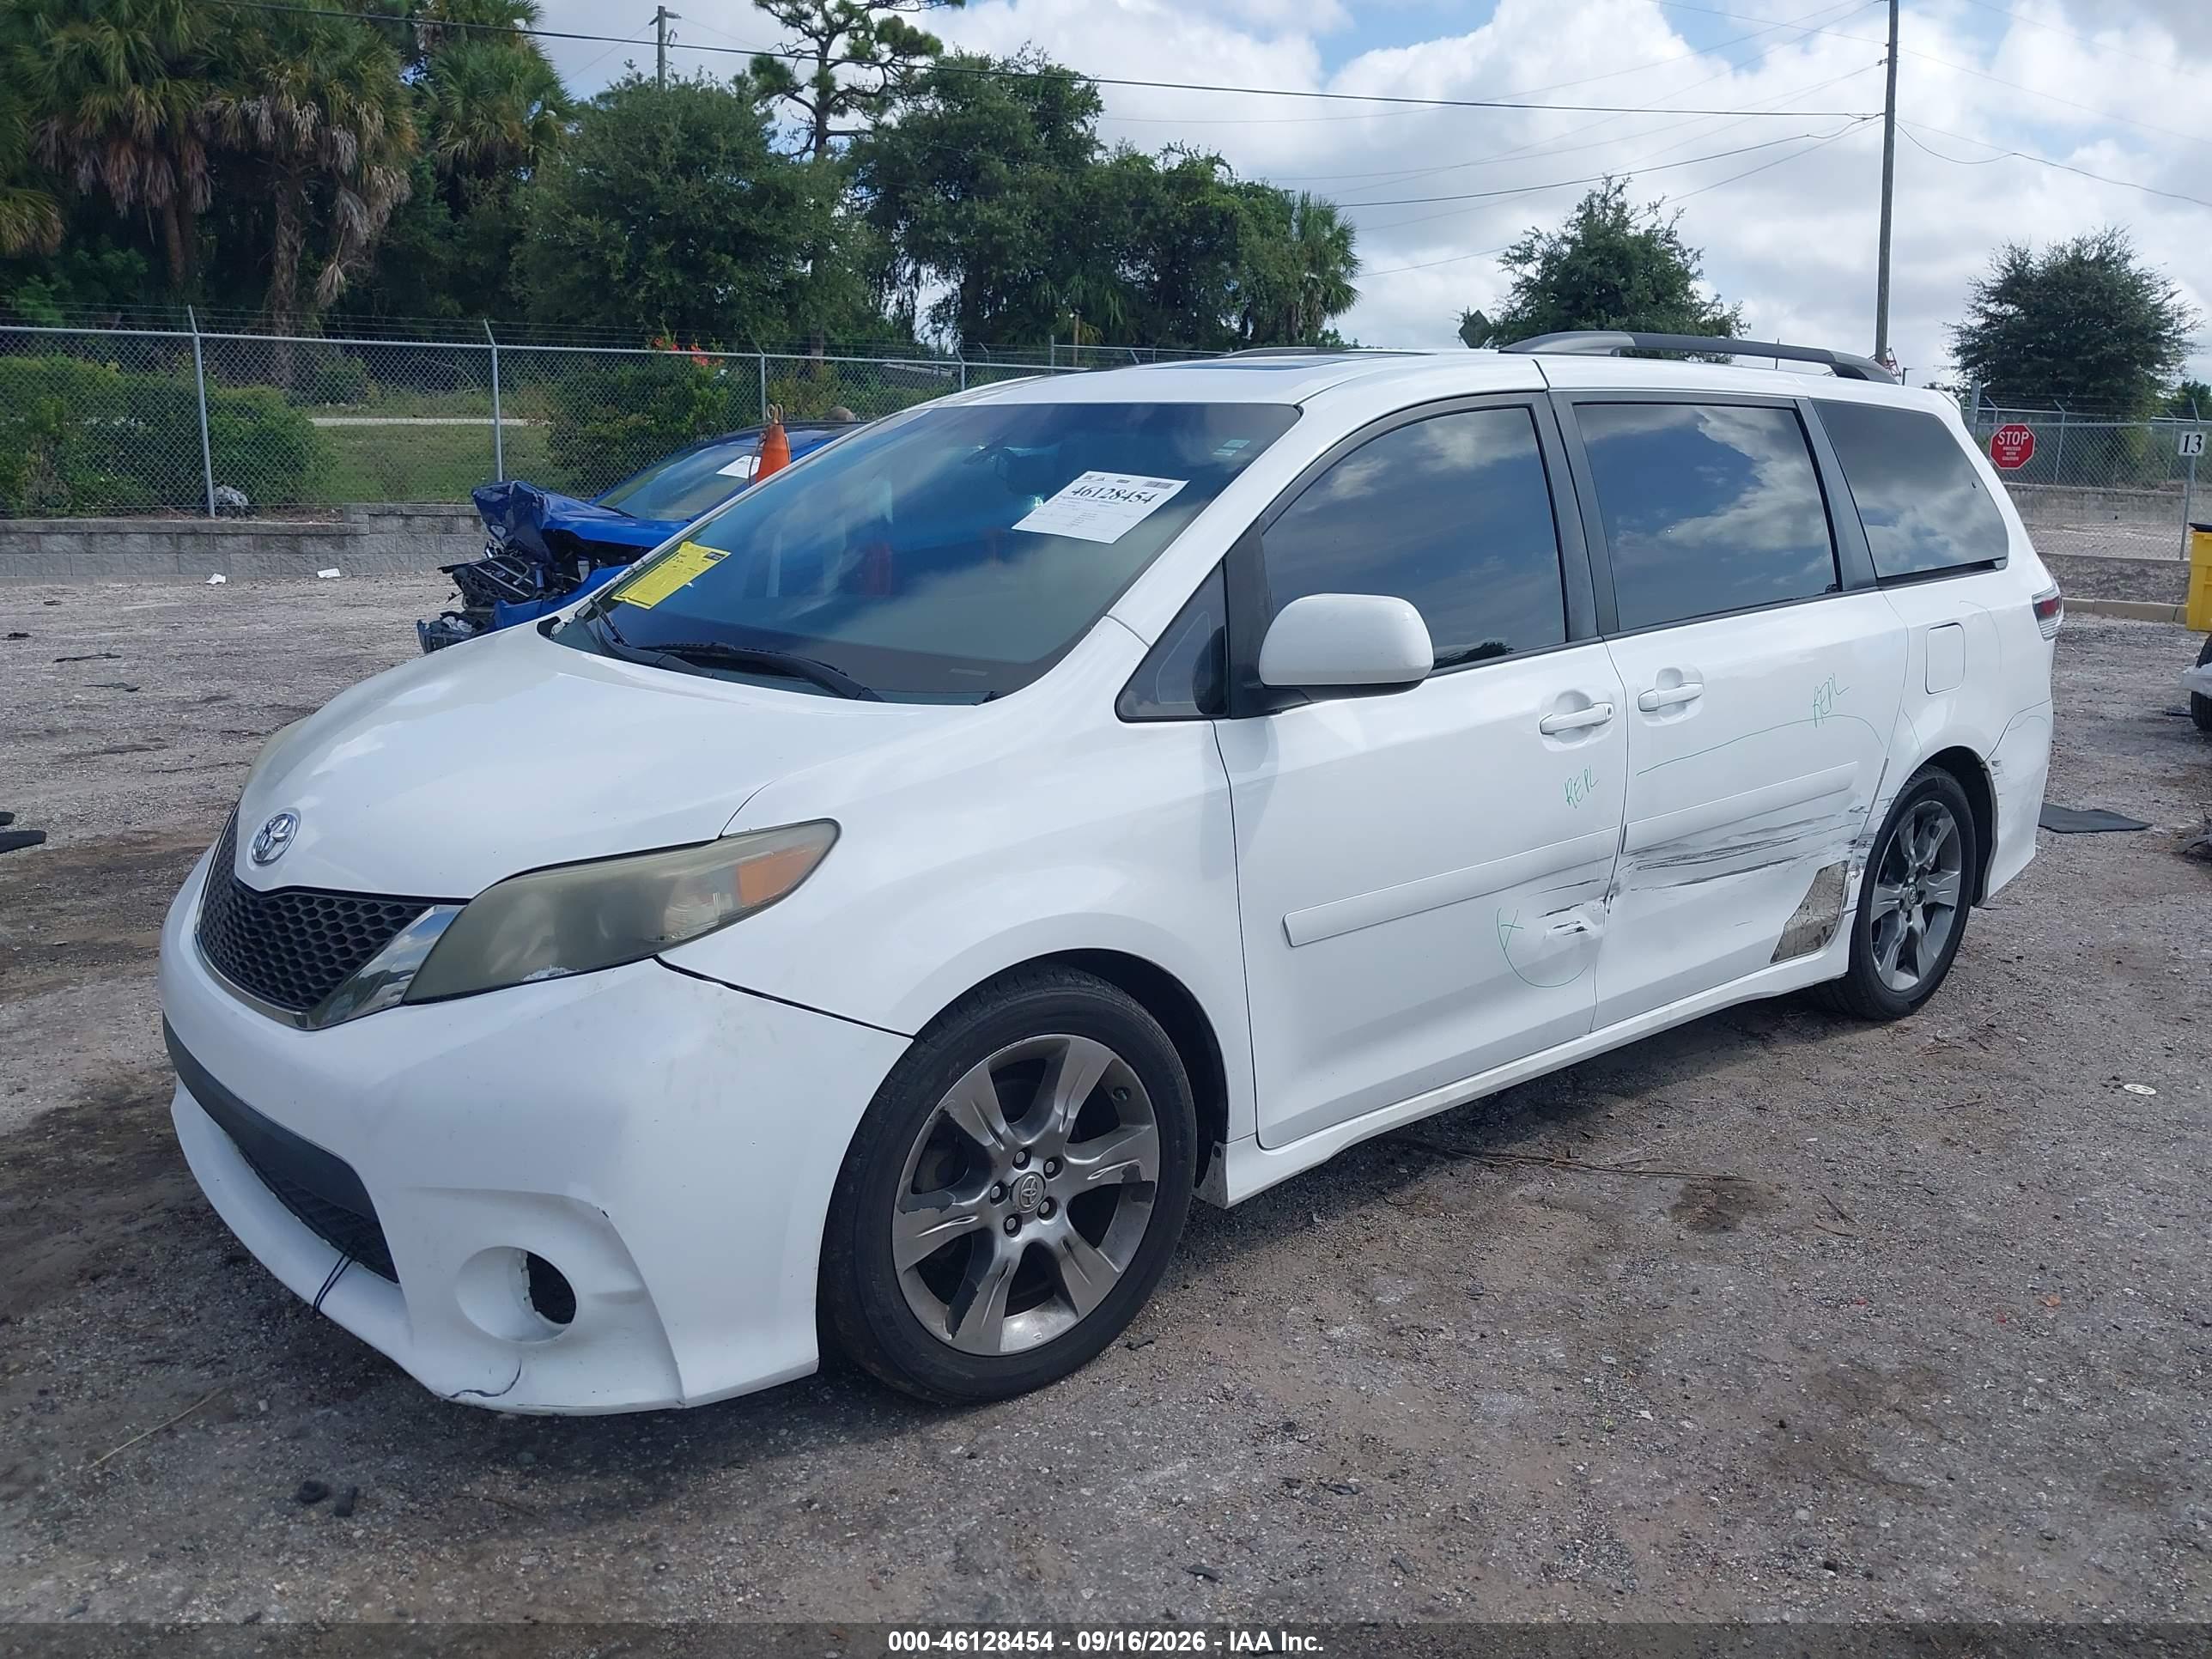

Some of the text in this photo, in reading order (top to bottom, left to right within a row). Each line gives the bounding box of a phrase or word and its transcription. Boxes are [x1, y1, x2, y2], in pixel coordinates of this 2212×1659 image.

[1997, 431, 2030, 446] STOP
[2183, 434, 2203, 454] 13
[1071, 484, 1159, 505] 46128454
